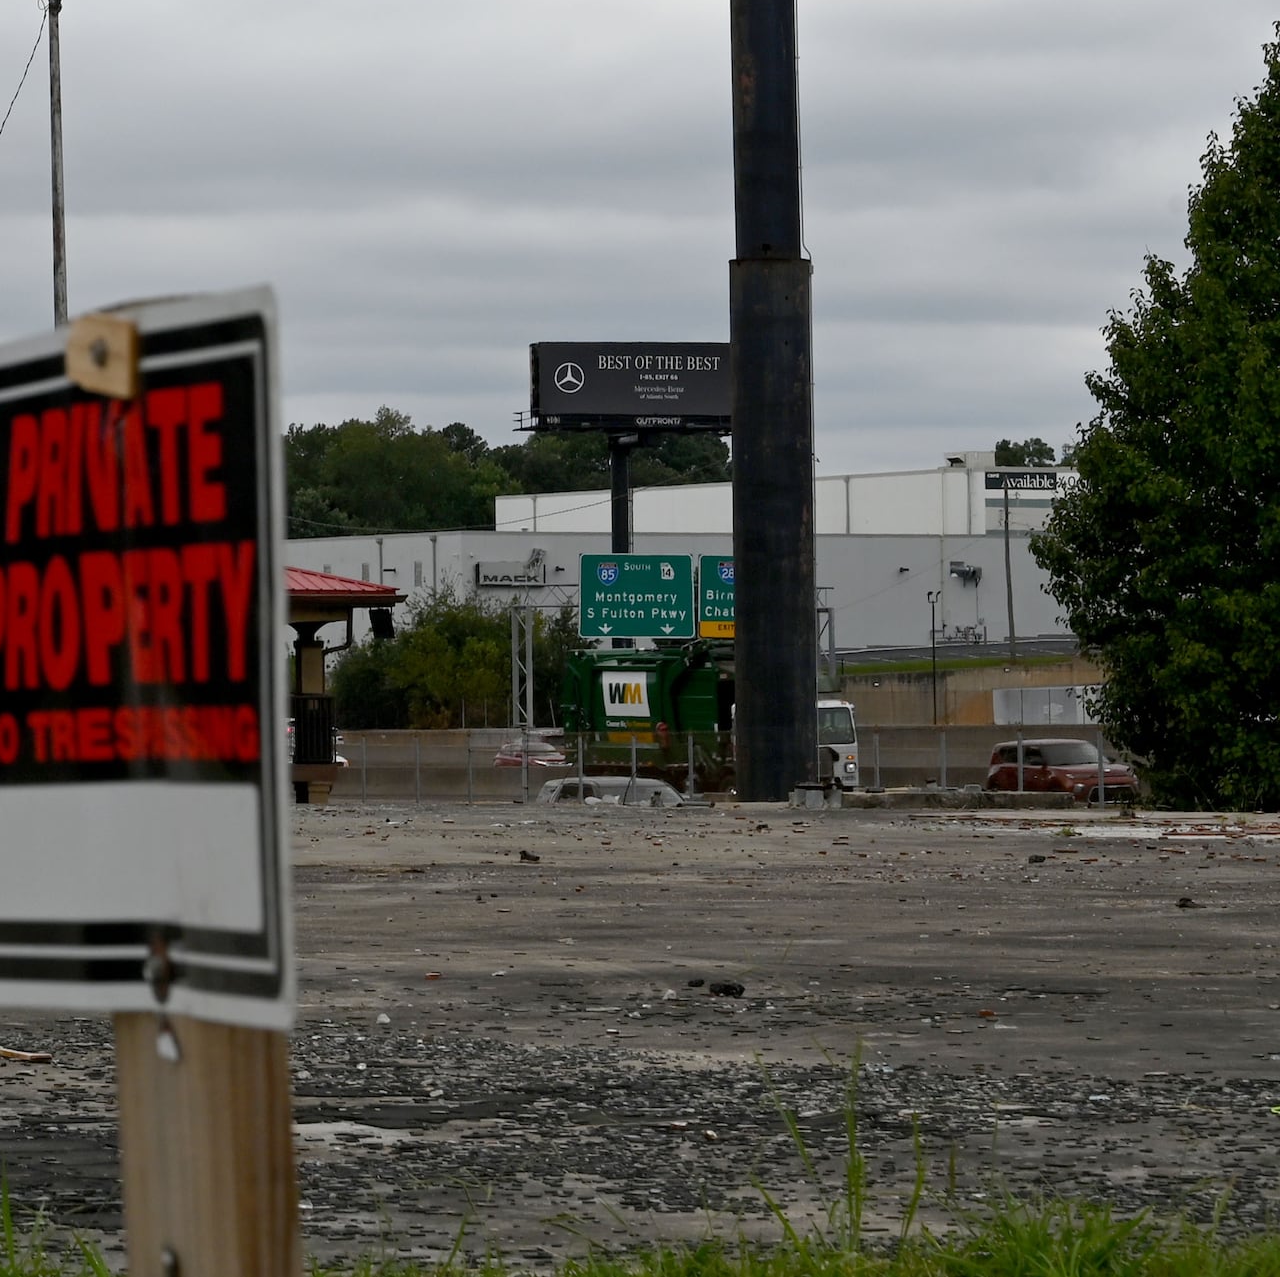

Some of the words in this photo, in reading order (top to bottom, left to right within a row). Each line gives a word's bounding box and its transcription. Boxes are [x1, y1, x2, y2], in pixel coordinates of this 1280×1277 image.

[598, 355, 631, 370] BEST
[634, 355, 653, 370] OF
[655, 355, 683, 370] THE
[686, 355, 721, 371] BEST
[5, 382, 226, 544] PRIVATE
[1001, 474, 1054, 489] Available
[483, 575, 540, 583] MACK
[601, 569, 615, 581] 85
[662, 567, 671, 578] 14
[595, 592, 677, 605] Montgomery
[587, 608, 595, 618] S
[602, 607, 644, 619] Fulton
[652, 608, 686, 621] Pkwy
[609, 683, 643, 704] WM
